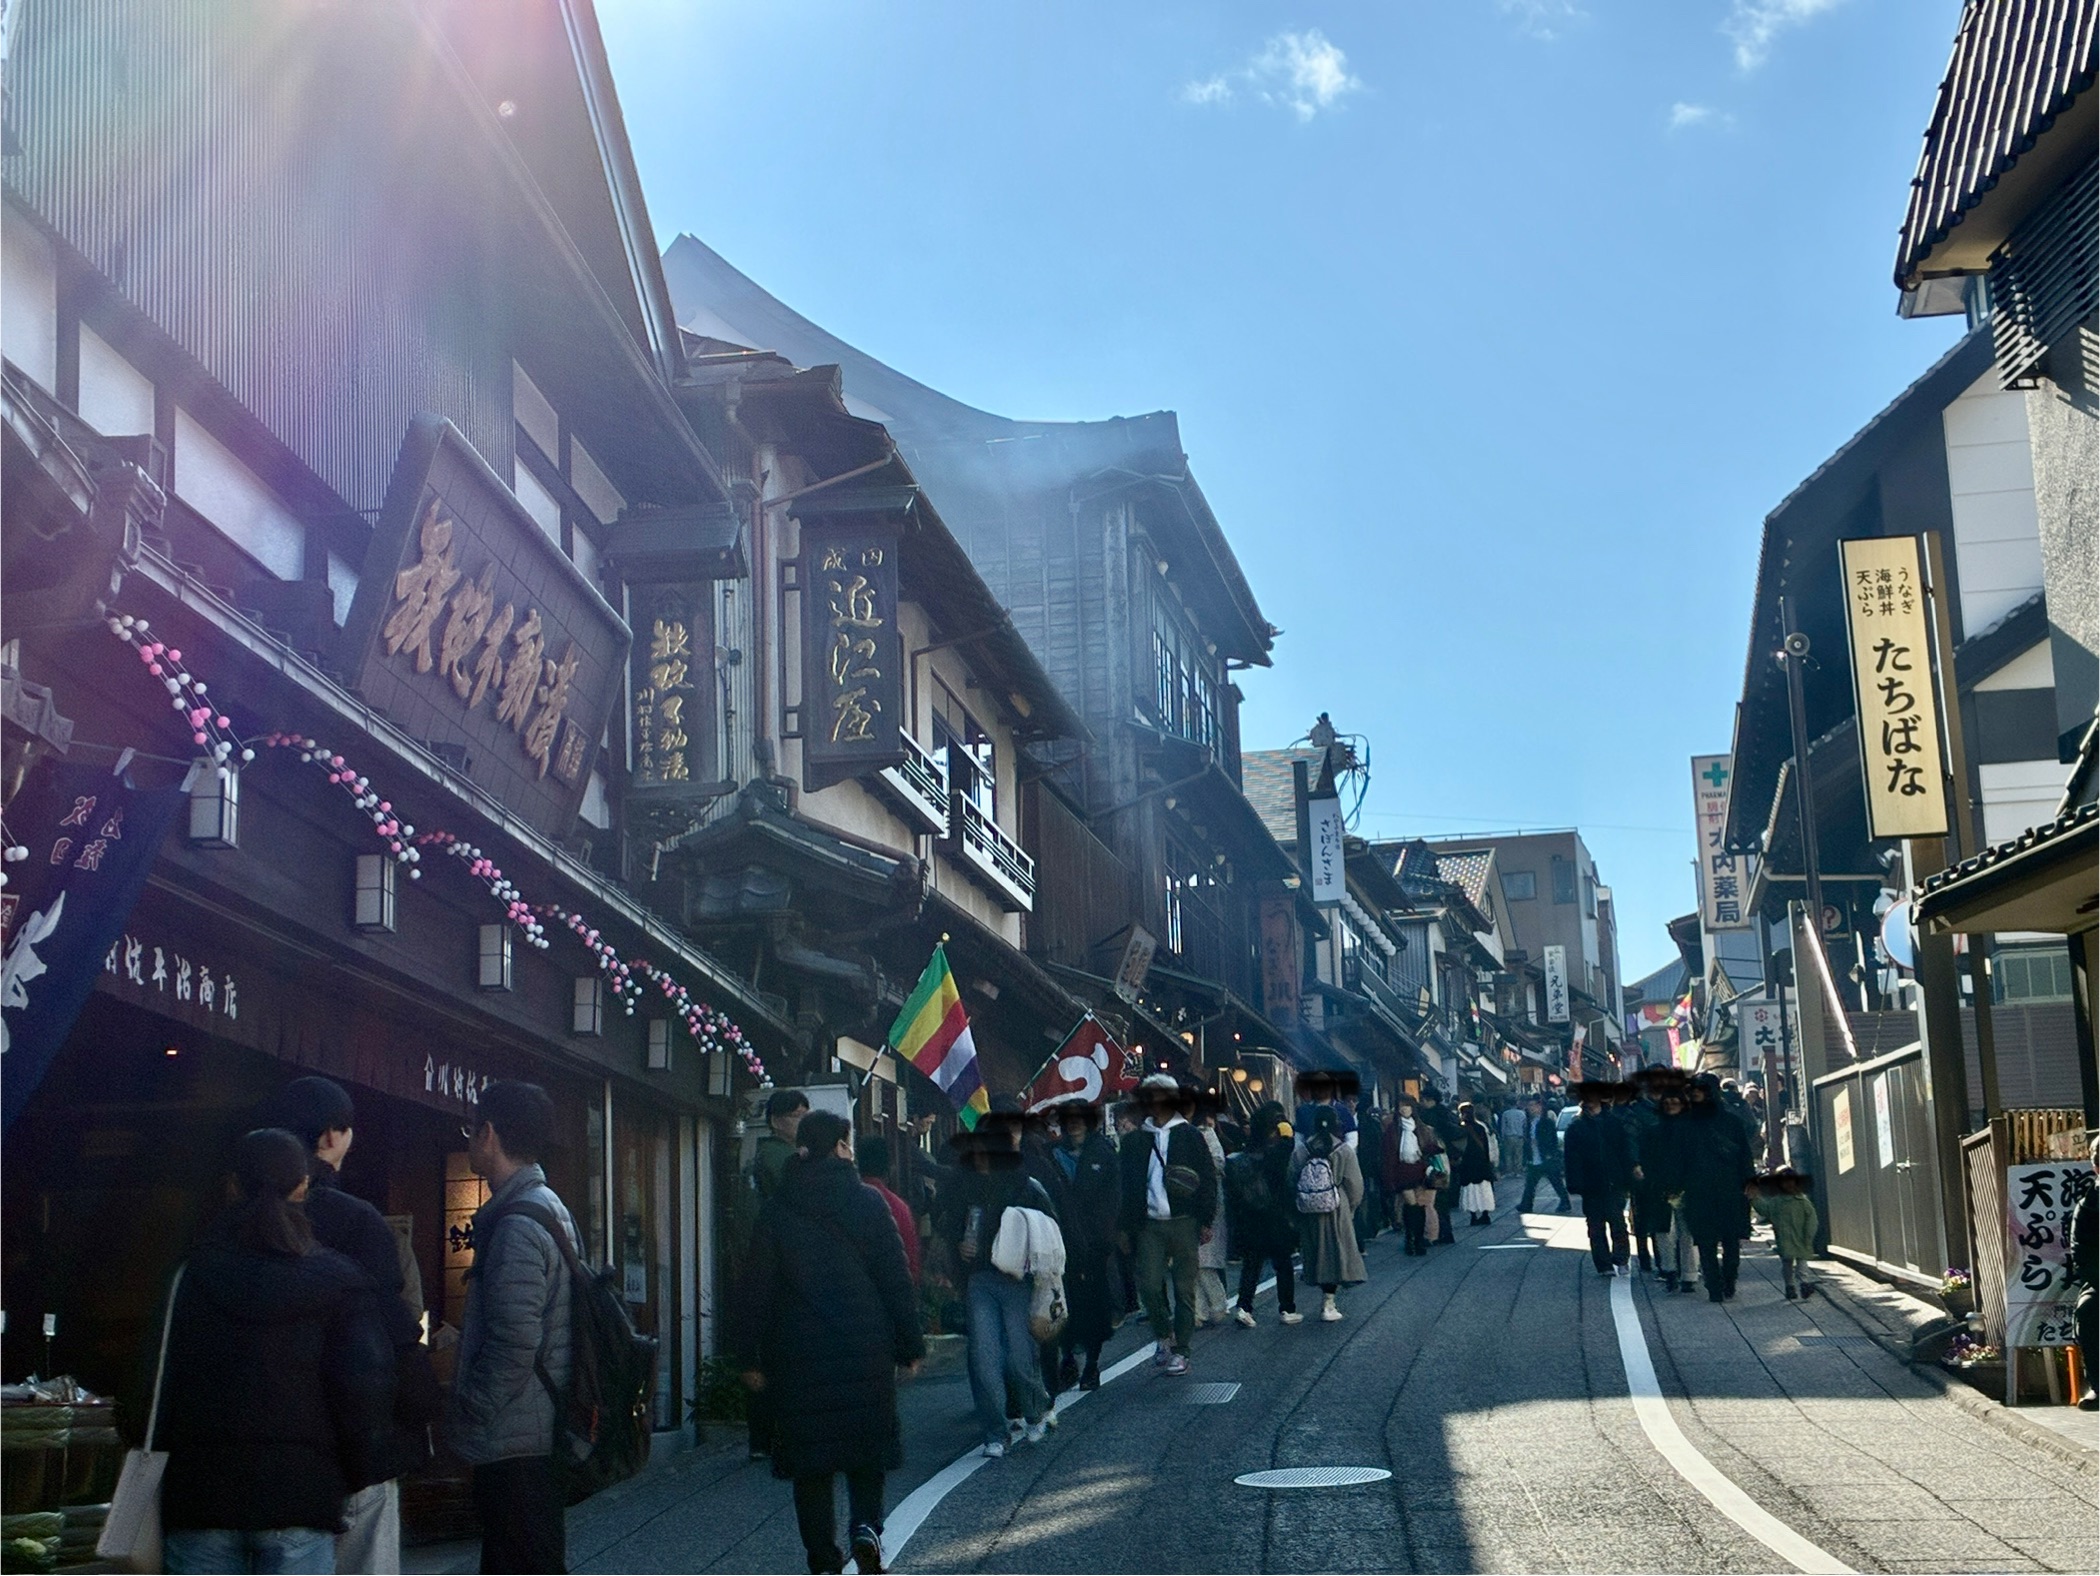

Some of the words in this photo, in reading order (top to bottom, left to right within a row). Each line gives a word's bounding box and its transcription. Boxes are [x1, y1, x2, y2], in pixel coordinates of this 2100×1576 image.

[1855, 570, 1875, 617] 天ぷら
[1874, 568, 1896, 617] 海鮮丼
[1897, 567, 1915, 615] うなぎ
[829, 575, 885, 743] 近江屋
[1873, 638, 1927, 797] たちばな
[2018, 1169, 2056, 1292] 天ぷら
